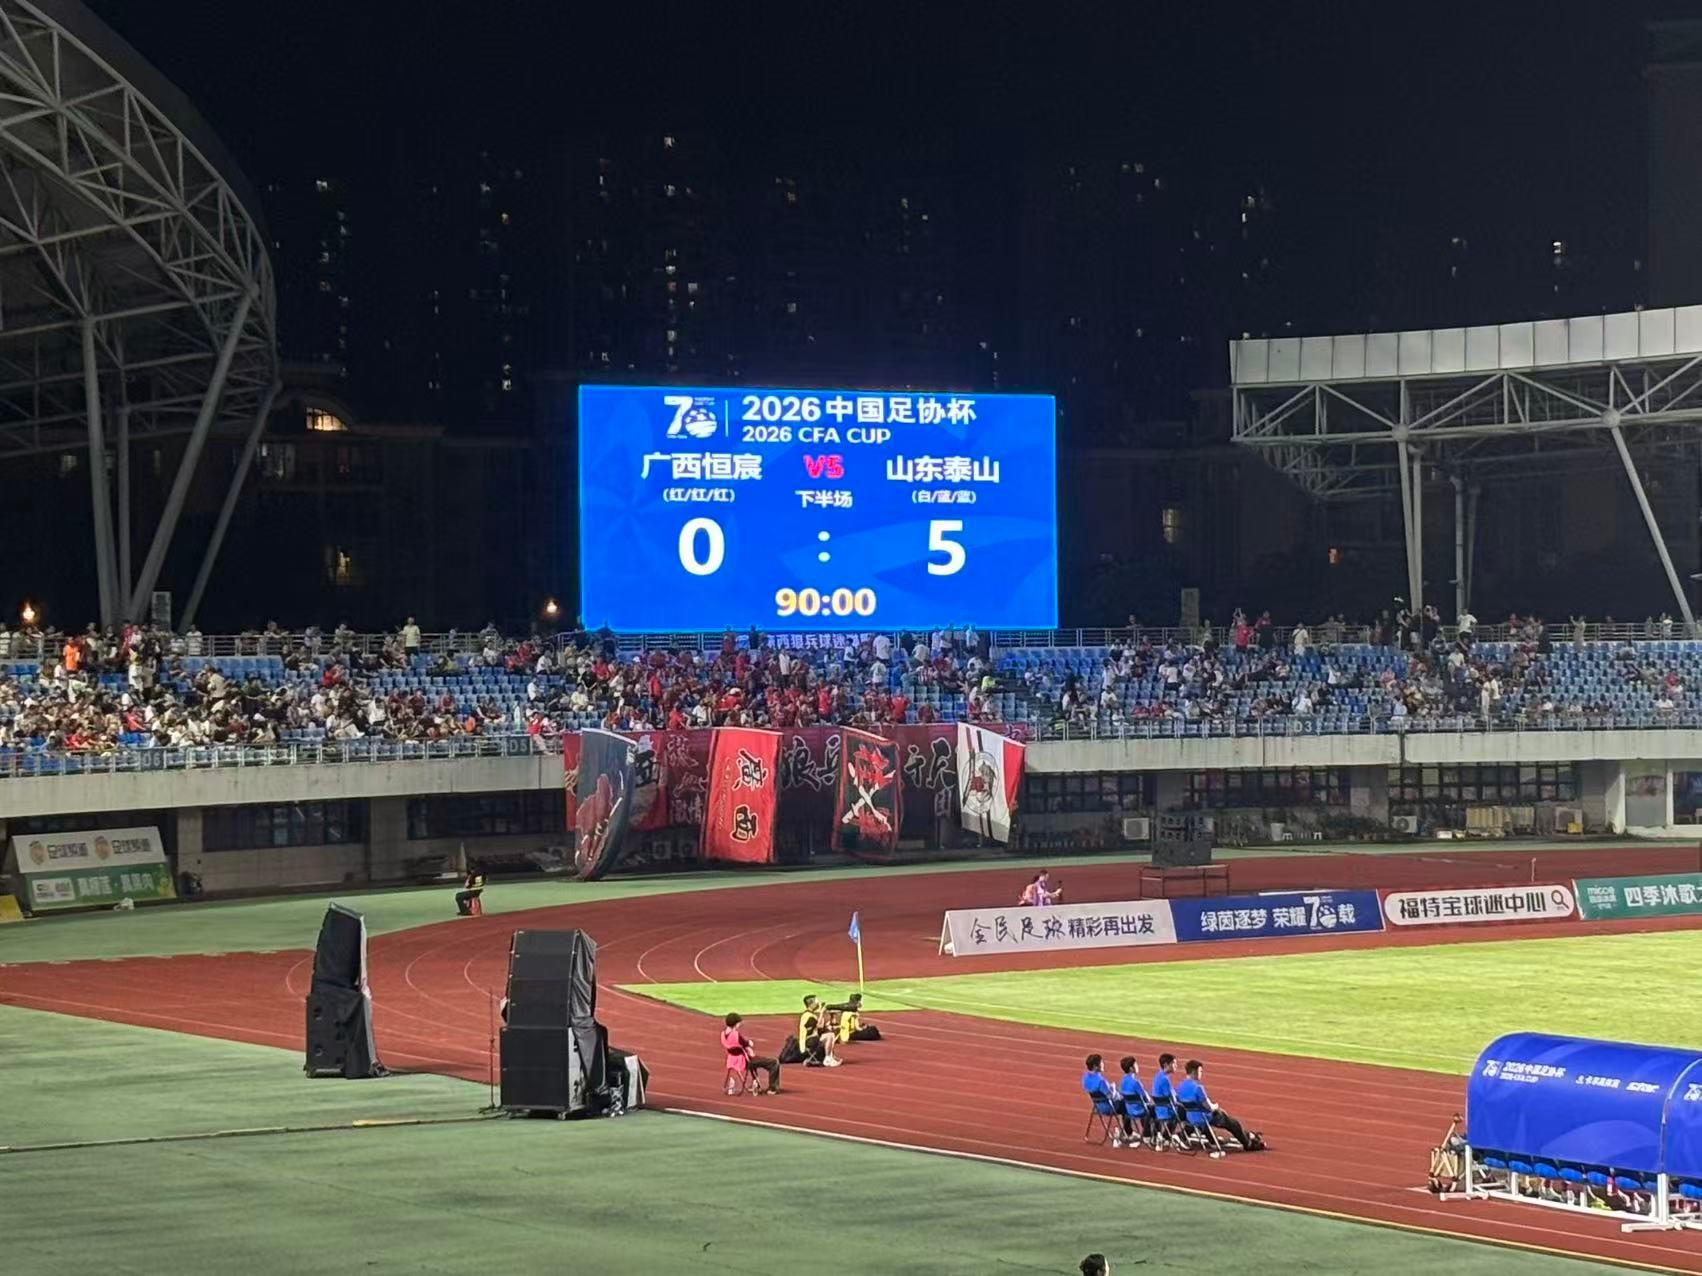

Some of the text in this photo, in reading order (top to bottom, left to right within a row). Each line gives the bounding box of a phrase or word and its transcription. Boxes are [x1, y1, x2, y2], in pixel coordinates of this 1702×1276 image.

[741, 395, 977, 426] 2026中国足协杯
[742, 426, 891, 444] 2026 CFA CUP
[640, 452, 763, 480] 广西恒宸
[803, 454, 844, 479] VS
[885, 455, 1000, 483] 山东泰山
[795, 490, 853, 508] 下半场
[678, 517, 725, 575] 0
[927, 519, 967, 576] 5
[775, 587, 876, 616] 90:00
[1399, 890, 1547, 919] 福特宝球迷中心
[1624, 884, 1702, 907] 四季沐歌
[1201, 908, 1268, 932] 绿茵逐梦
